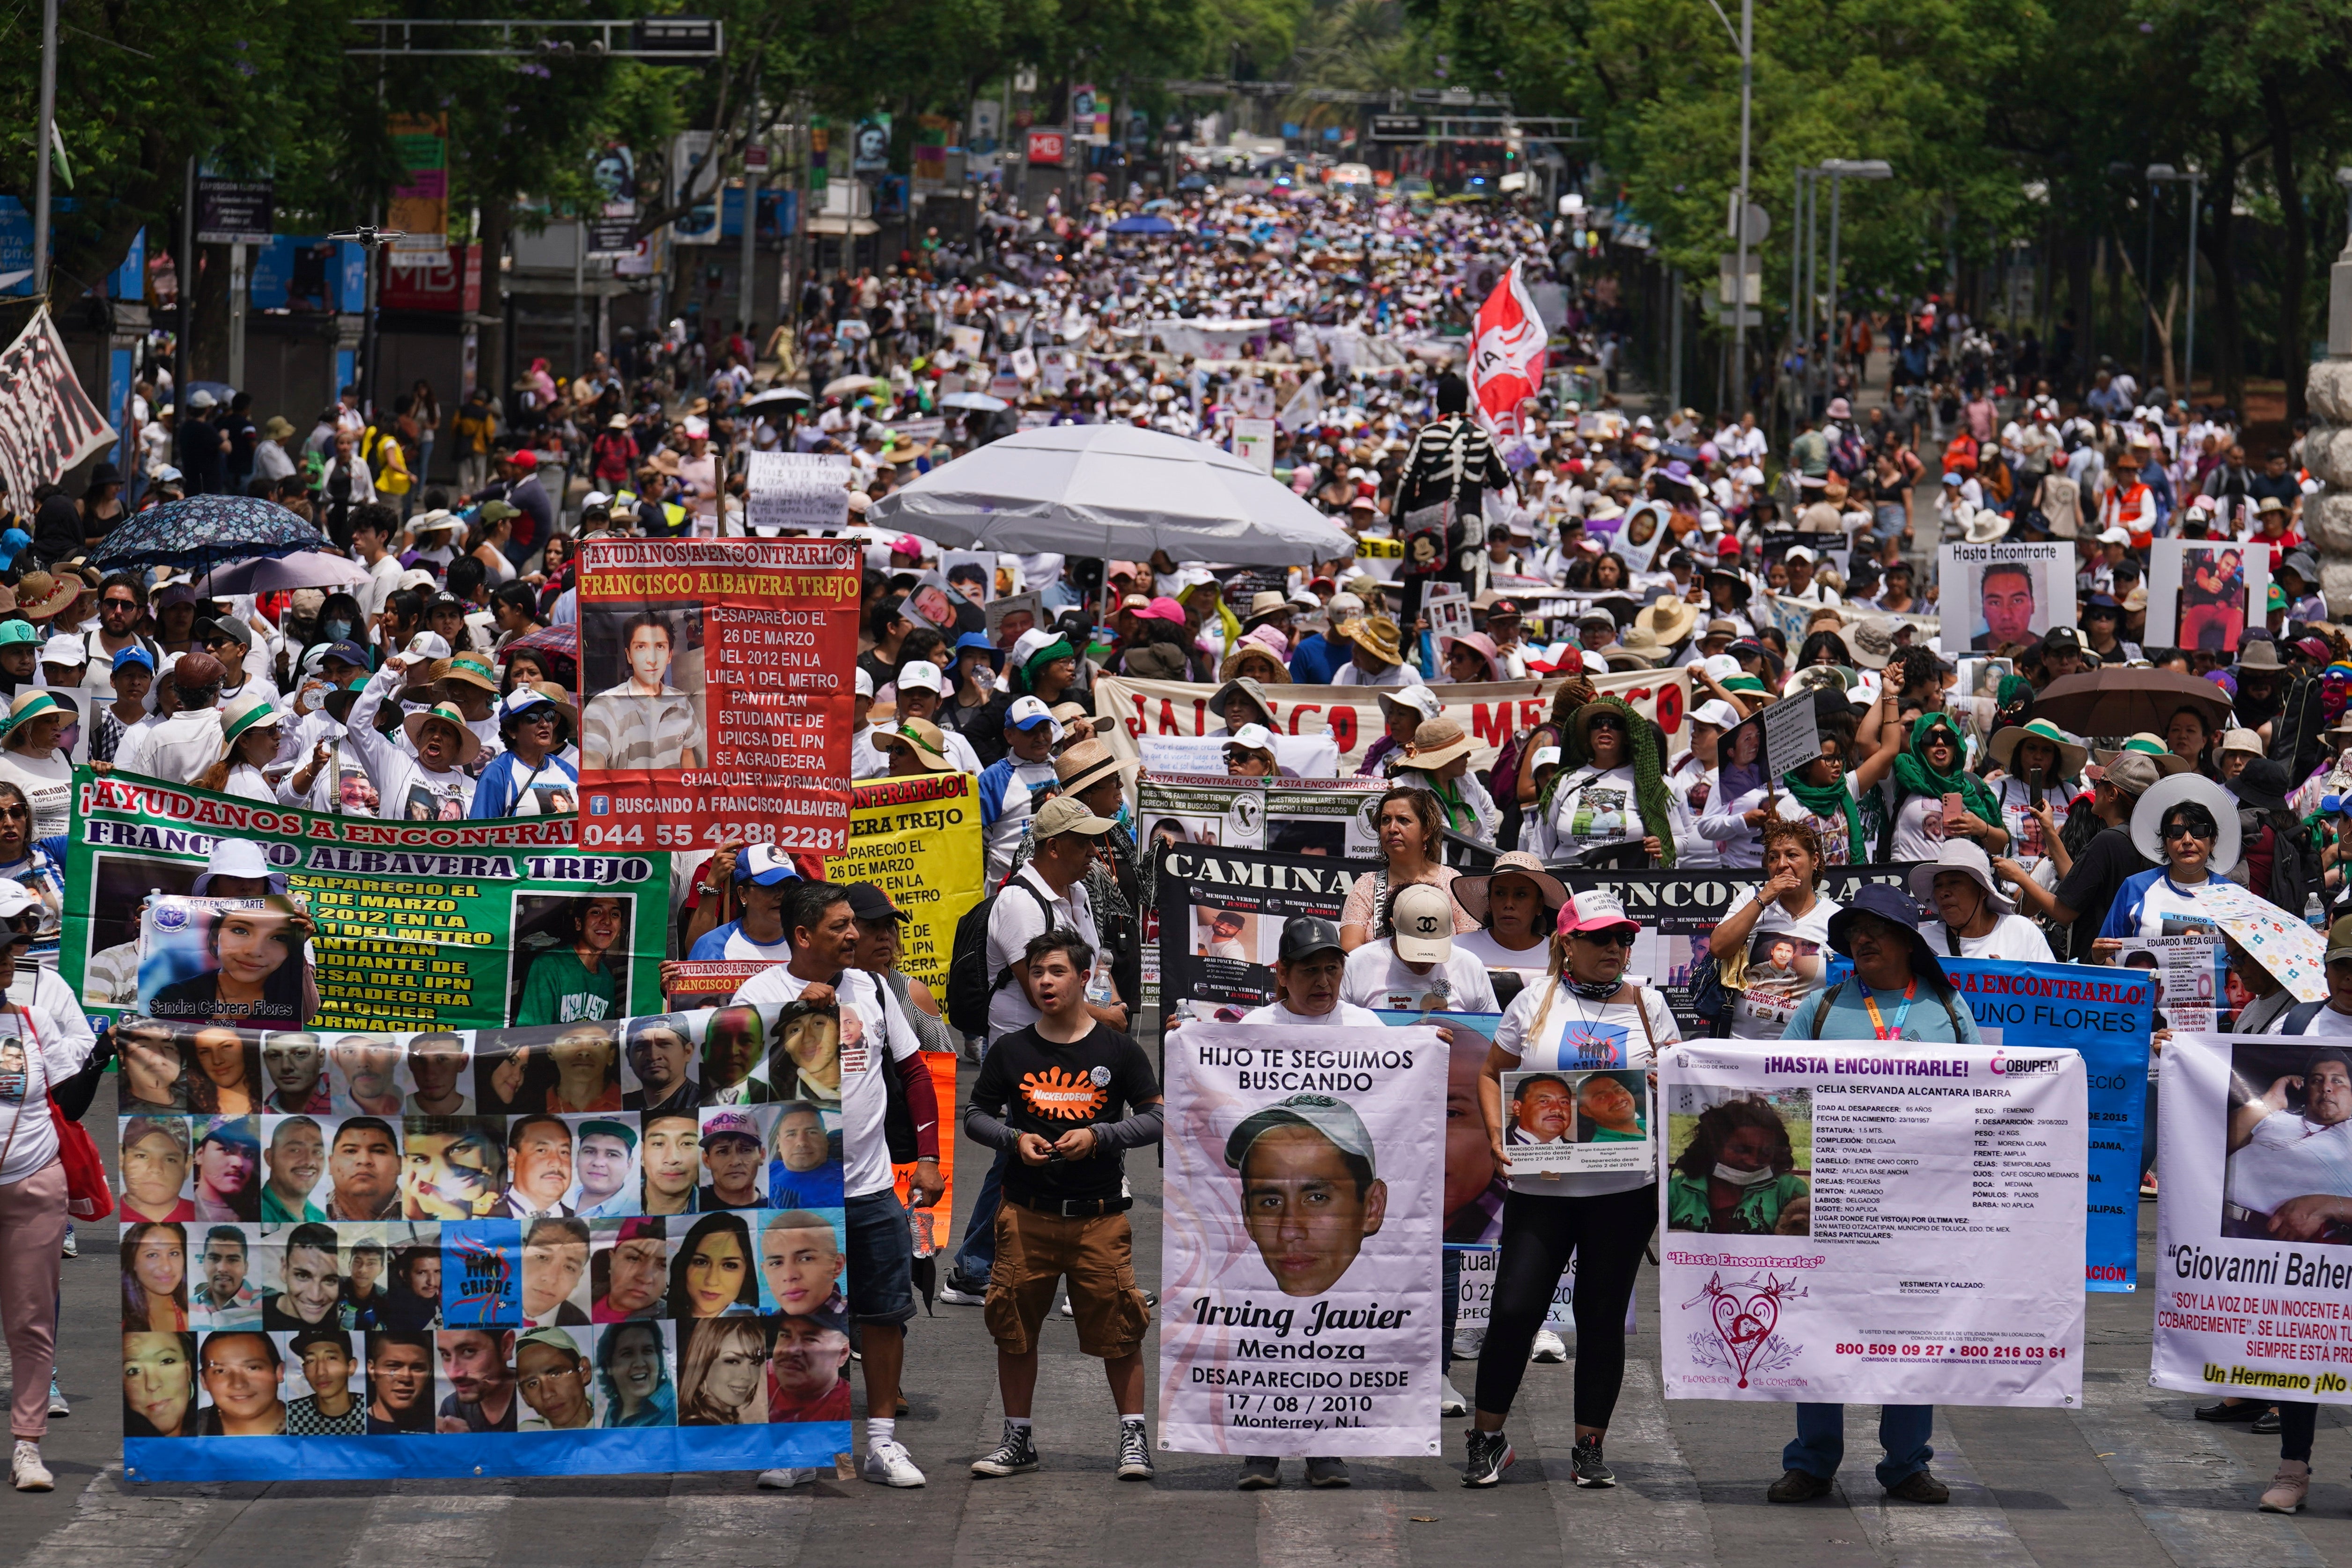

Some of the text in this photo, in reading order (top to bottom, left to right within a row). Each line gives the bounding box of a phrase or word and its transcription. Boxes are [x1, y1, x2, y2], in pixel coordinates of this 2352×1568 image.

[584, 545, 854, 568] ¡AYUDANOS A ENCONTRARLO!
[1954, 545, 2056, 561] Hasta Encontrarte
[580, 573, 858, 602] FRANCISCO ALBAVERA TREJO
[712, 608, 826, 626] DESAPARECIO EL
[724, 629, 815, 646] 26 DE MARZO
[720, 649, 820, 667] DEL 2012 EN LA
[707, 670, 744, 685] LINEA
[759, 672, 785, 686] DEL
[789, 674, 838, 689] METRO
[732, 691, 807, 707] PANTITLAN
[1766, 691, 1813, 721] DESAPARECIDO
[719, 710, 824, 729] ESTUDIANTE DE
[718, 731, 824, 749] UPIICSA DEL IPN
[716, 752, 826, 770] SE AGRADECERA
[681, 773, 850, 793] CUALQUIER INFORMACION
[1176, 776, 1259, 787] ENCONTRARLOS
[1173, 792, 1209, 801] FAMILIARES
[616, 797, 847, 817] BUSCANDO A FRANCISCO ALBAVERA
[1187, 802, 1220, 810] BUSCADOS
[584, 823, 845, 850] 044 55 4288 2281
[528, 857, 648, 883] TREJO
[210, 900, 265, 909] ENCONTRARTE
[2147, 938, 2180, 947] EDUARDO
[1750, 990, 1791, 1004] FRANCISCO
[1981, 975, 2146, 1005] ENCONTRARLO!
[149, 1000, 292, 1016] Sandra Cabrera Flores
[1740, 994, 1774, 1006] ALBAVERA
[1868, 1001, 1879, 1022] CHUBB
[1897, 1001, 1908, 1022] CHUBB
[2035, 1005, 2135, 1032] FLORES
[1200, 1047, 1413, 1069] HIJO TE SEGUIMOS
[1765, 1057, 1829, 1074] ¡HASTA
[1835, 1058, 1969, 1077] ENCONTRARLE!
[1239, 1071, 1372, 1091] BUSCANDO
[1817, 1085, 2011, 1097] CELIA SERVANDA ALCANTARA IBARRA
[2201, 1295, 2215, 1310] LA
[2219, 1296, 2241, 1311] VOZ
[2244, 1298, 2259, 1313] DE
[2262, 1299, 2278, 1315] UN
[2281, 1301, 2340, 1319] INOCENTE
[1193, 1297, 1411, 1337] Irving Javier
[2258, 1323, 2273, 1337] SE
[2276, 1325, 2337, 1341] LLEVARON
[1237, 1339, 1365, 1359] Mendoza
[1836, 1343, 1944, 1356] 800 509 09 27
[1961, 1346, 2066, 1358] 800 216 03 61
[2247, 1341, 2329, 1362] SIEMPRE ESTÁ
[1193, 1367, 1408, 1388] DESAPARECIDO DESDE
[1766, 1377, 1807, 1386] CORAZÓN
[2203, 1363, 2225, 1382] Un
[2230, 1367, 2309, 1389] Hermano
[1227, 1394, 1249, 1410] 17
[1274, 1396, 1298, 1412] 08
[1323, 1396, 1371, 1412] 2010
[1233, 1414, 1366, 1432] Monterrey, N.L.
